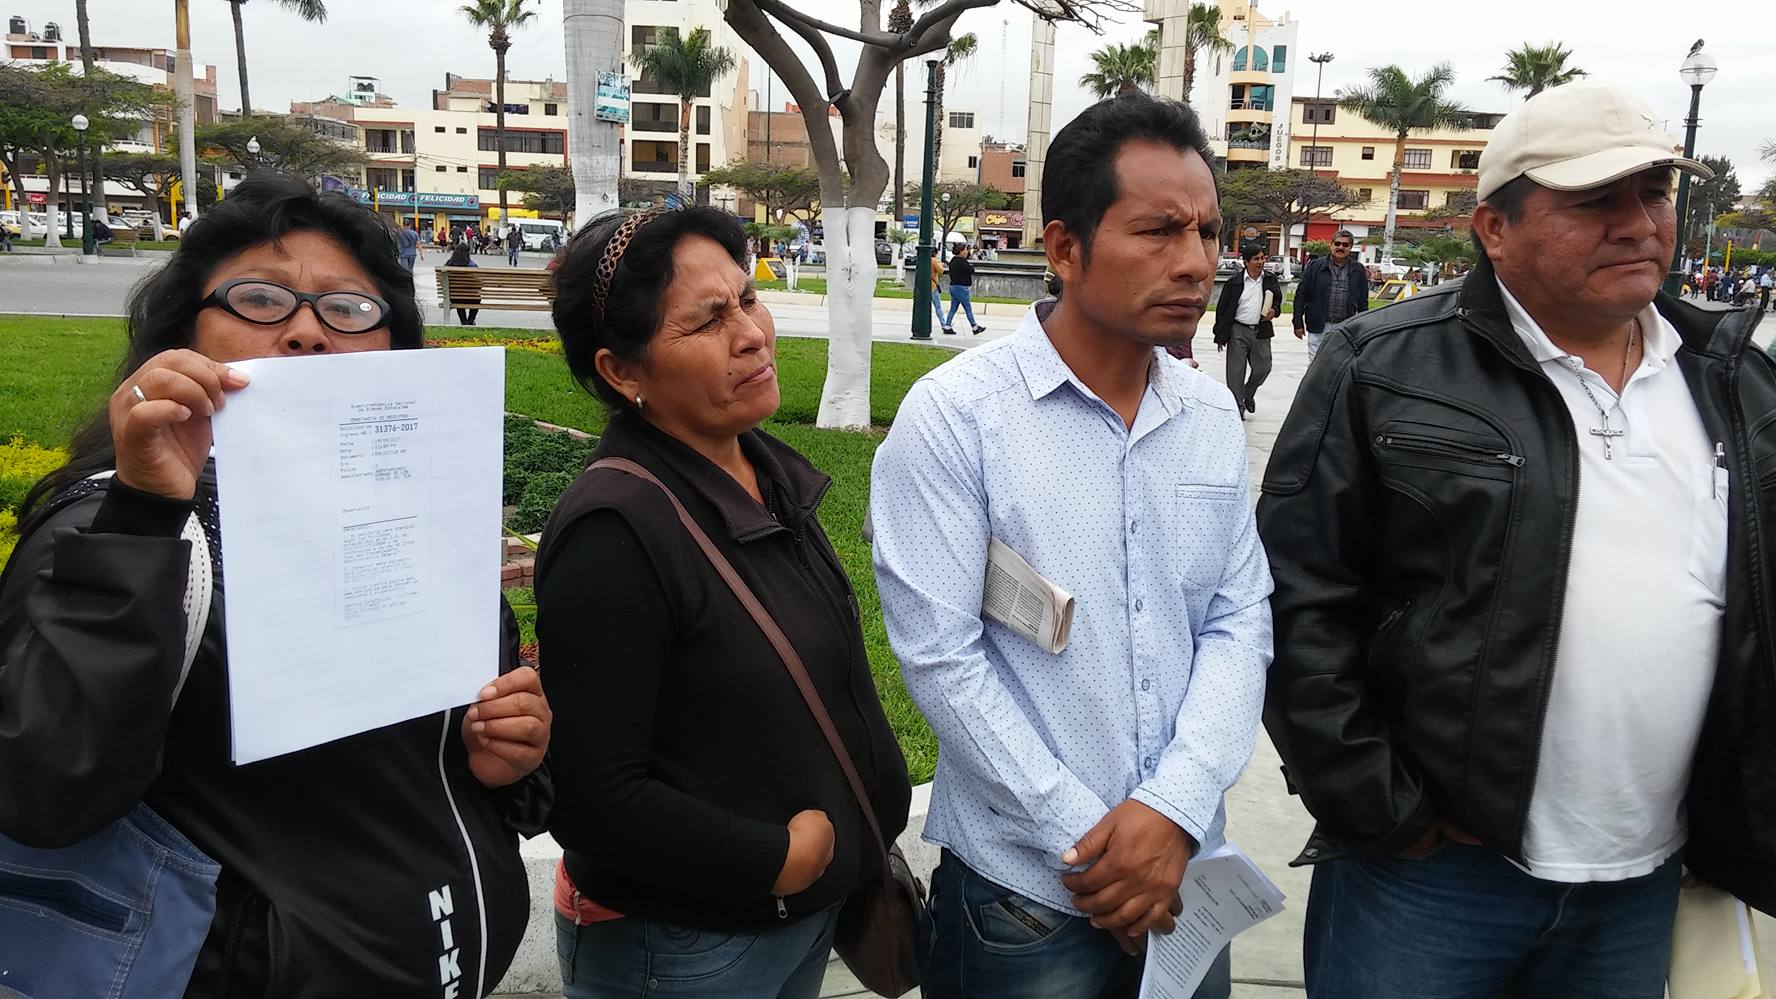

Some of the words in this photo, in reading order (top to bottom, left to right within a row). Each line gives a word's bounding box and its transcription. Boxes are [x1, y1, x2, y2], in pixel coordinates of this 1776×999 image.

[1274, 123, 1283, 161] JUEGOS
[361, 192, 407, 200] FICIDAD
[420, 195, 465, 203] FELICIDAD
[374, 423, 419, 433] 31376-2017
[428, 884, 462, 999] NIKE
